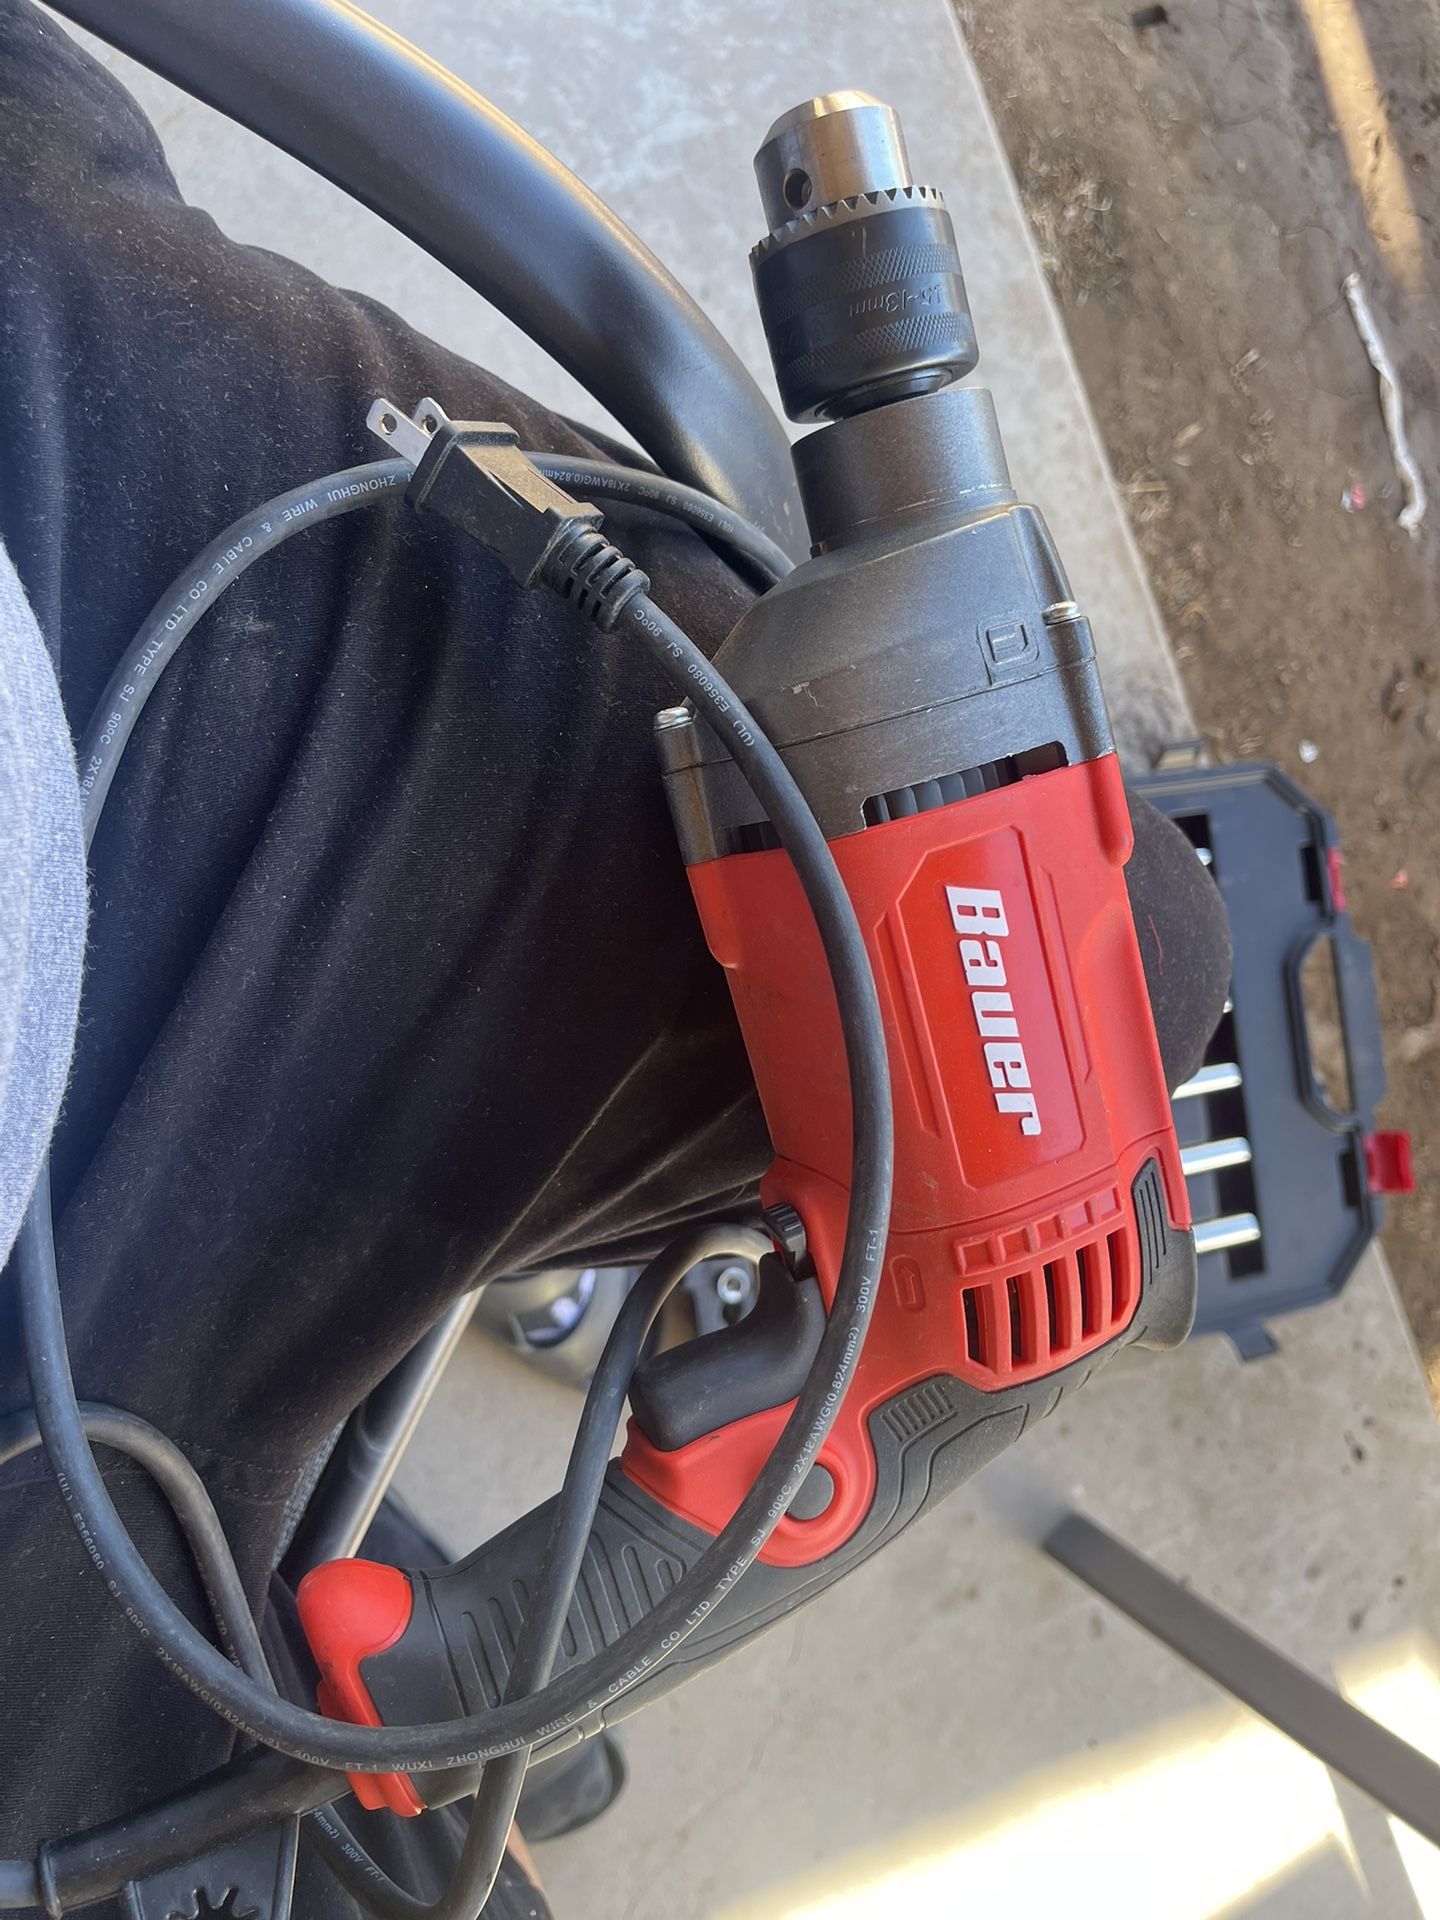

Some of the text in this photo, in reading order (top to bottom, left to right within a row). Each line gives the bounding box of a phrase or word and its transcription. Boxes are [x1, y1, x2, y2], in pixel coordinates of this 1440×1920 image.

[327, 475, 397, 502] ZHONGHUI
[665, 494, 679, 506] SJ
[282, 499, 319, 522] WIRE
[261, 522, 272, 533] &
[211, 536, 253, 574] CABLE
[189, 580, 208, 600] CO
[164, 604, 188, 630] LTD
[134, 640, 164, 675] TYPE
[666, 642, 683, 658] SJ
[119, 684, 135, 702] SJ
[687, 664, 730, 713] E356080
[732, 719, 756, 747] (UL)
[945, 885, 1042, 1135] Bauer
[56, 1472, 75, 1502] (UL)
[107, 1579, 123, 1598] SJ
[392, 1759, 434, 1772] WUXI
[446, 1738, 526, 1767] ZHONGHUI
[536, 1711, 576, 1737] WIRE
[586, 1699, 599, 1709] &
[608, 1655, 652, 1694] CABLE
[660, 1630, 681, 1650] CO
[685, 1600, 711, 1626] LTD
[714, 1555, 748, 1591] TYPE
[751, 1528, 767, 1546] SJ
[793, 1326, 861, 1474] 2X18AWG(0.824mm2)
[856, 1276, 872, 1313] 300V
[866, 1229, 879, 1262] FT-1
[228, 1643, 242, 1669] TYP
[341, 1842, 365, 1863] 300V
